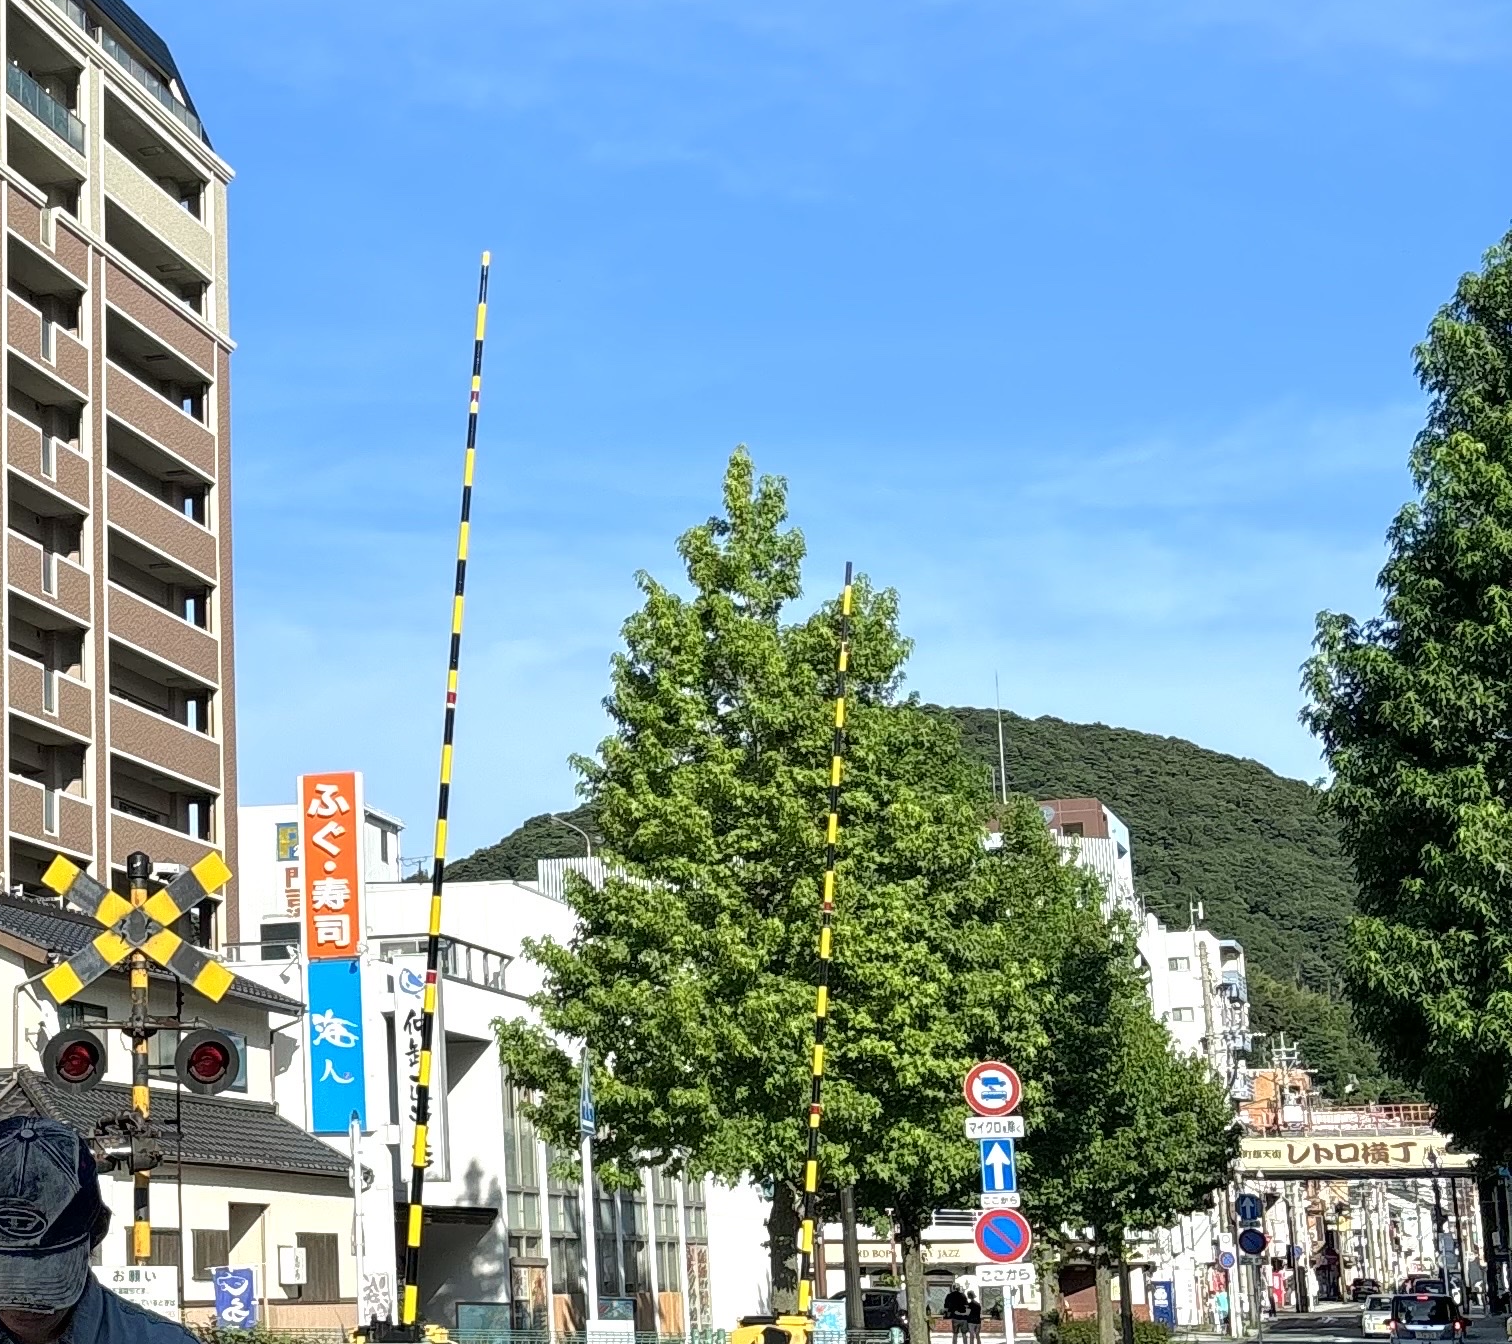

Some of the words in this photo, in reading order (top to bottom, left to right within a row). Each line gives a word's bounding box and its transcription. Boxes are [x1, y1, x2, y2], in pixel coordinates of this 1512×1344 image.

[306, 783, 351, 948] ふぐ・寿司
[1287, 1142, 1418, 1164] レトロ横丁
[983, 1196, 1018, 1205] ここから
[937, 1249, 961, 1259] JAZZ
[112, 1269, 157, 1283] お願い
[981, 1268, 1031, 1282] ここから
